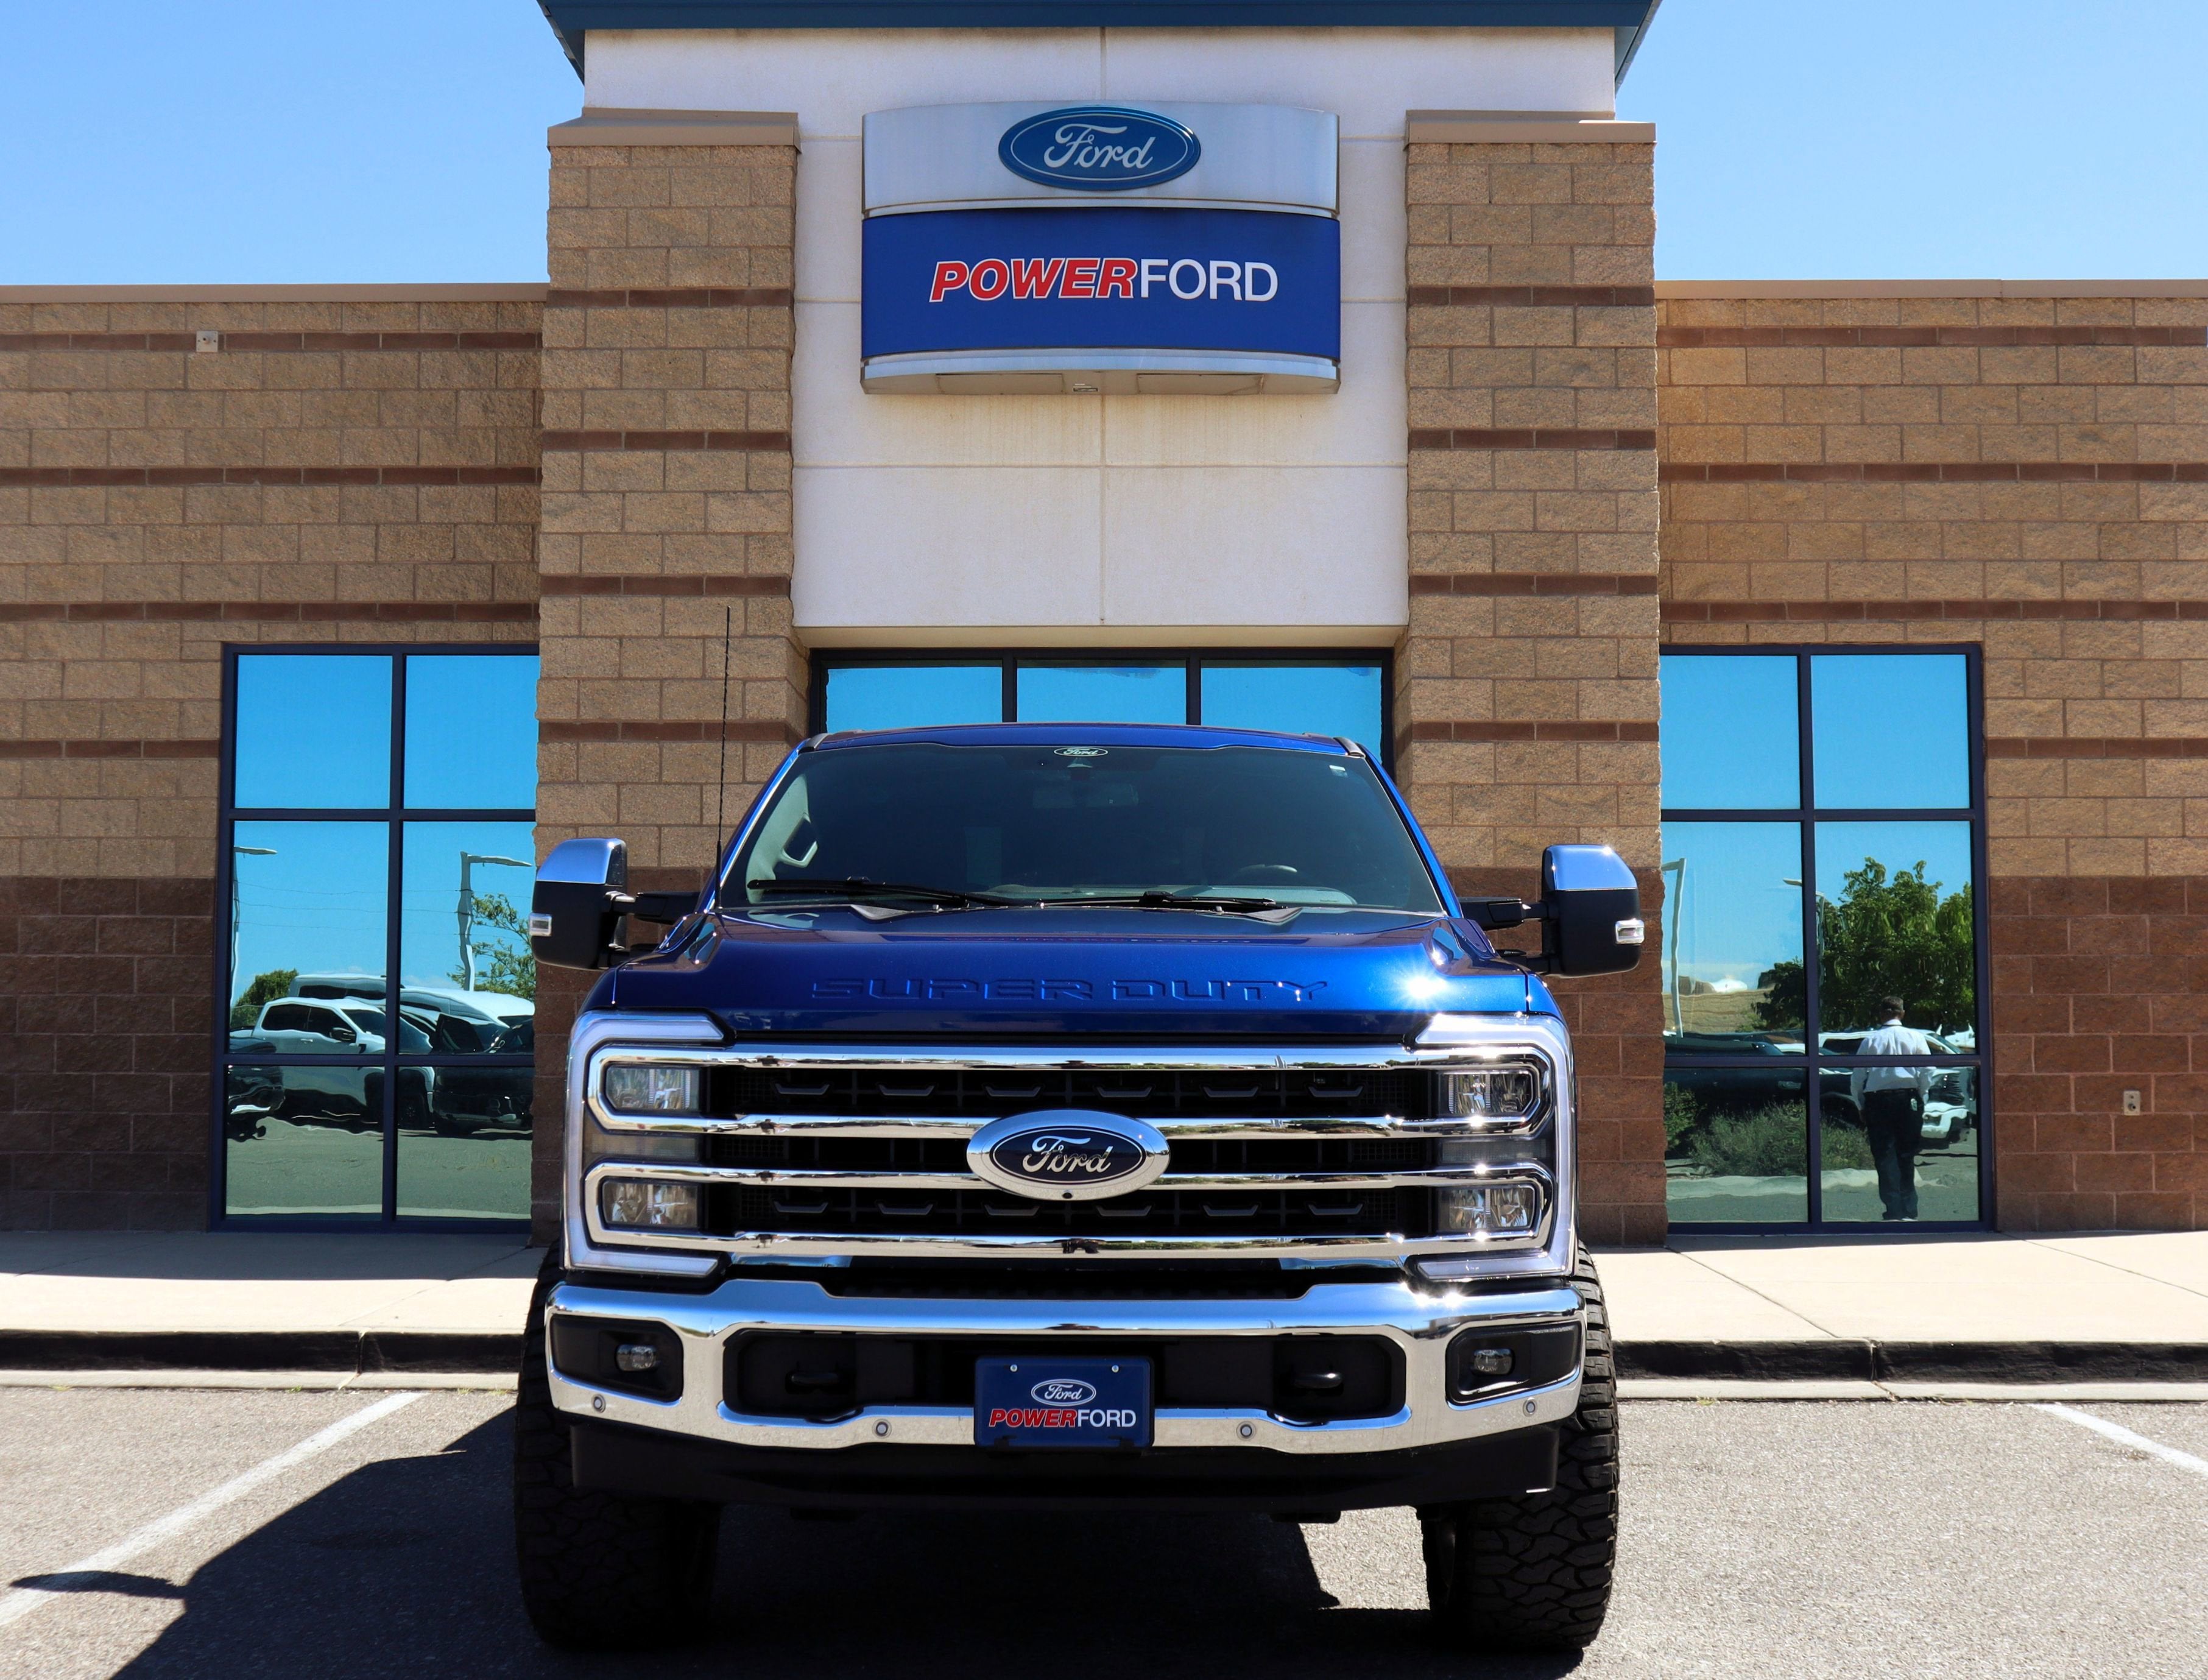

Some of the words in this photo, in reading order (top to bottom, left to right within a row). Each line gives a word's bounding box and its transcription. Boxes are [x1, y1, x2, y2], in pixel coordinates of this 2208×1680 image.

[1043, 124, 1155, 169] Ford
[812, 979, 1093, 1000] SUPER
[1112, 980, 1328, 1001] DUTY
[1023, 1135, 1113, 1173] Ford
[1044, 1384, 1082, 1400] Ford
